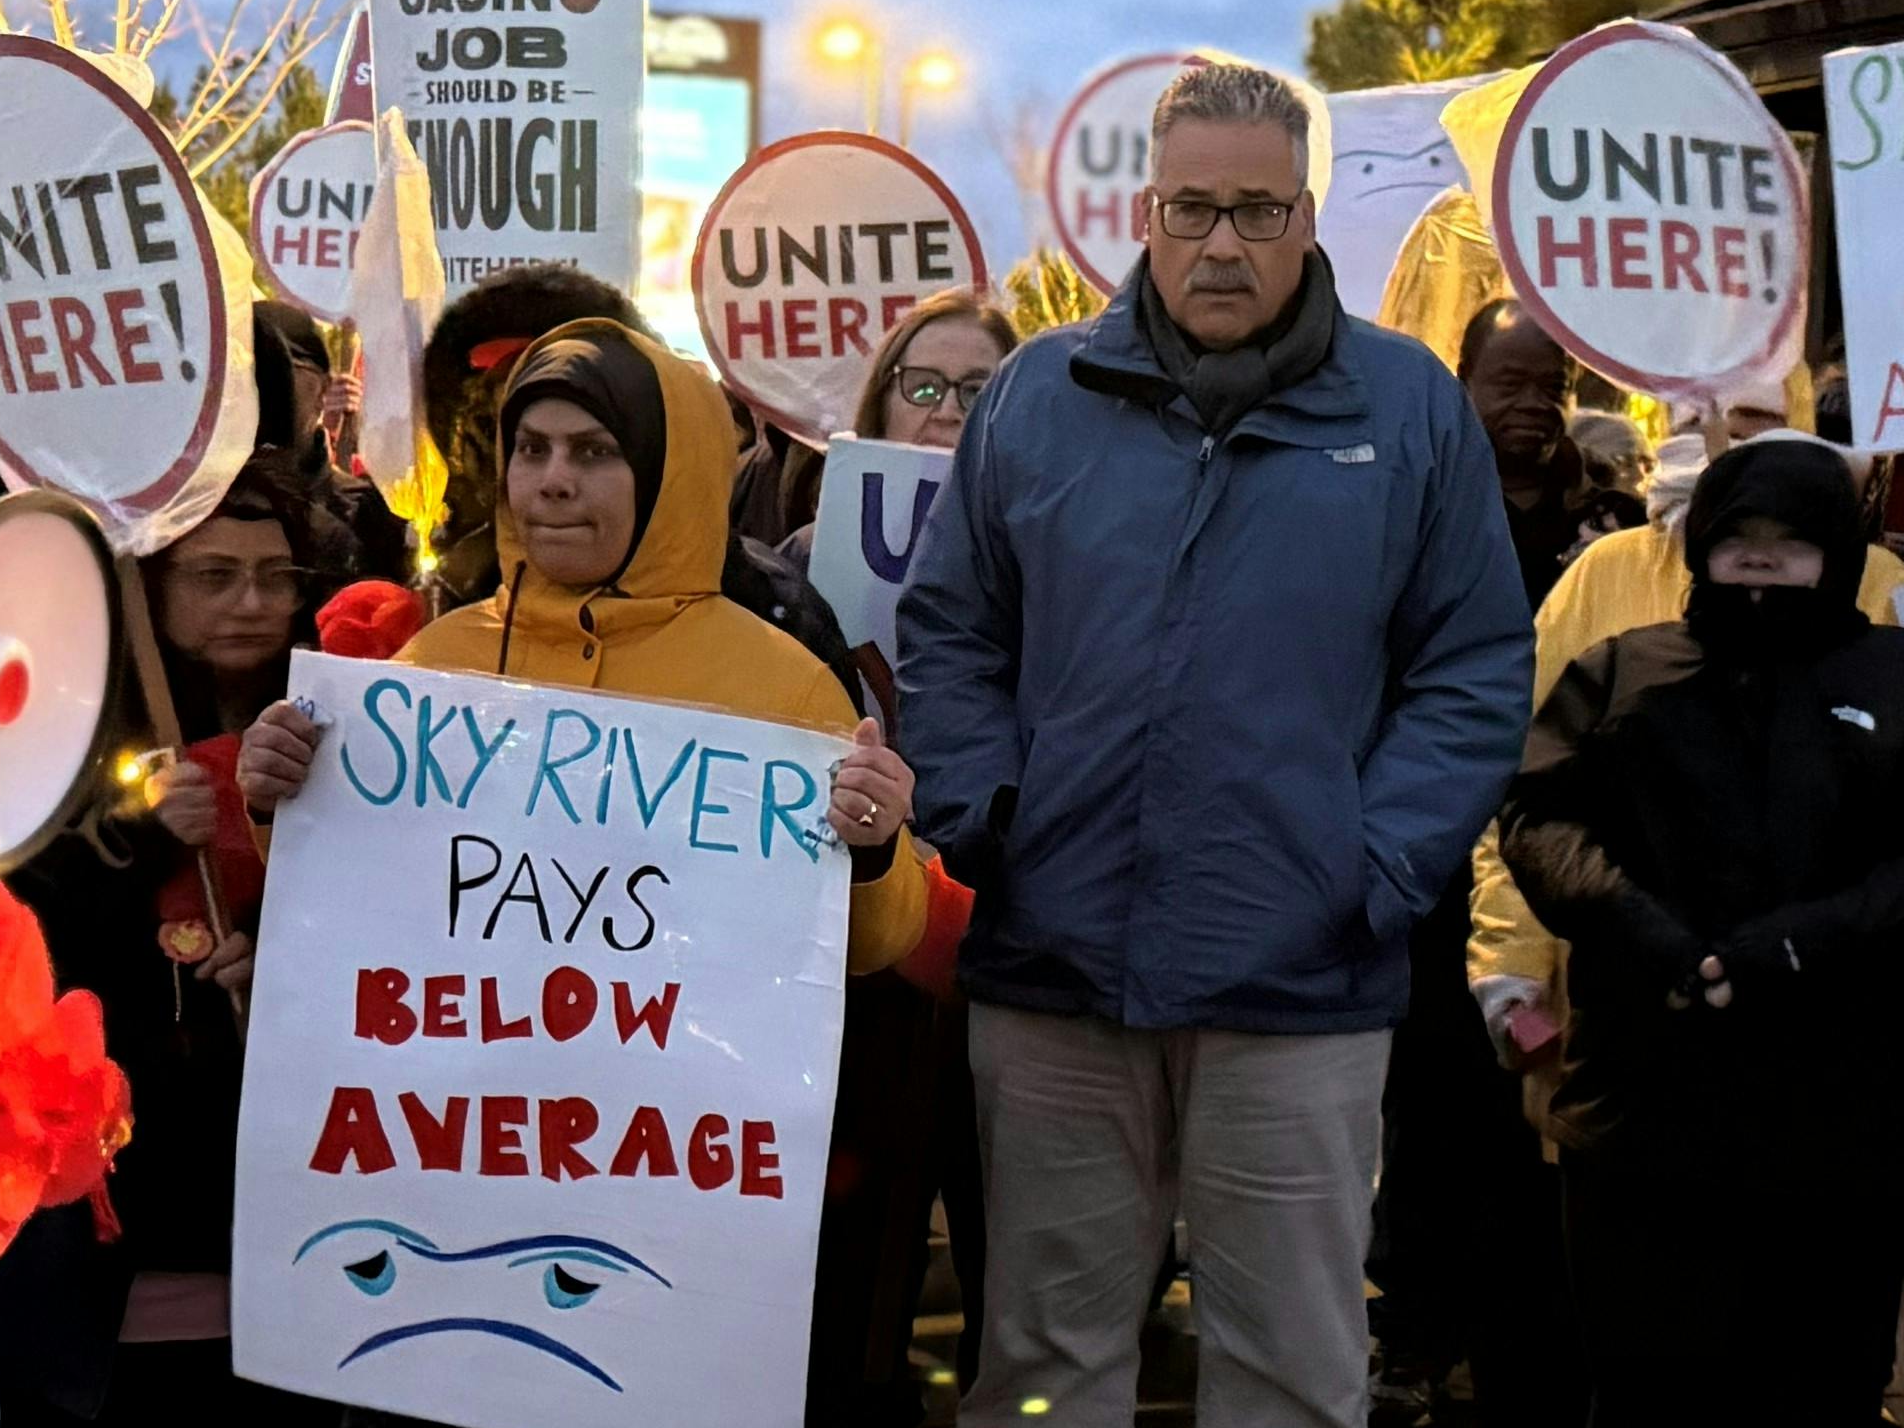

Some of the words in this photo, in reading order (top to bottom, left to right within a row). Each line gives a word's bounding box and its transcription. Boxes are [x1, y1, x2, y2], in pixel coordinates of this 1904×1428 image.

[416, 27, 567, 71] JOB
[426, 80, 516, 104] SHOULD
[527, 80, 566, 103] BE
[276, 177, 374, 222] UNI
[1531, 127, 1780, 216] UNITE
[272, 225, 360, 270] HE
[719, 220, 955, 288] UNITE
[1536, 215, 1777, 305] HERE!
[724, 294, 915, 361] HER
[340, 678, 516, 809] SKY
[524, 708, 820, 863] RIVER
[449, 833, 671, 952] PAYS
[354, 965, 682, 1050] BELOW
[308, 1086, 785, 1200] AVERAGE
